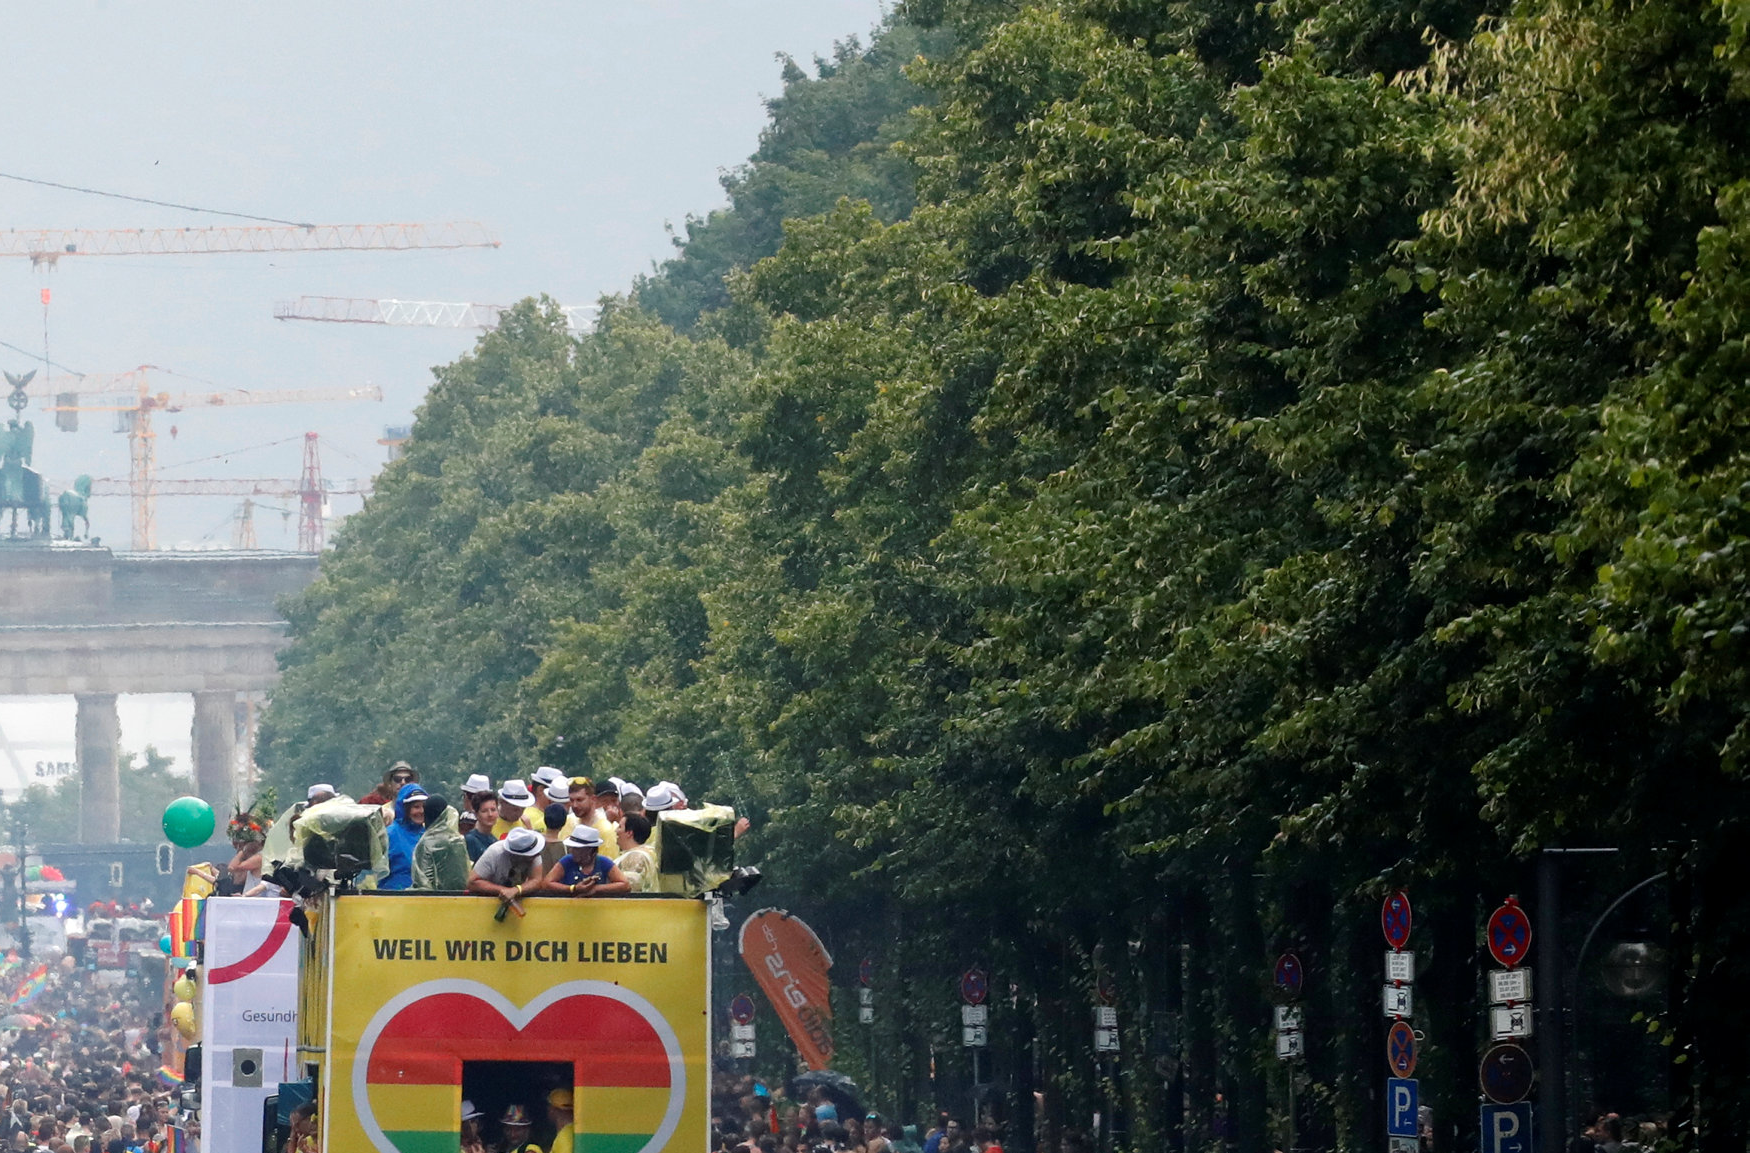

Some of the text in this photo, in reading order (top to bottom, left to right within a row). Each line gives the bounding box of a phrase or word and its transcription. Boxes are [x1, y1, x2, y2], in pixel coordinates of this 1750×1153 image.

[373, 939, 668, 964] WEIL WIR DICH LIEBEN
[1395, 1086, 1411, 1128] P
